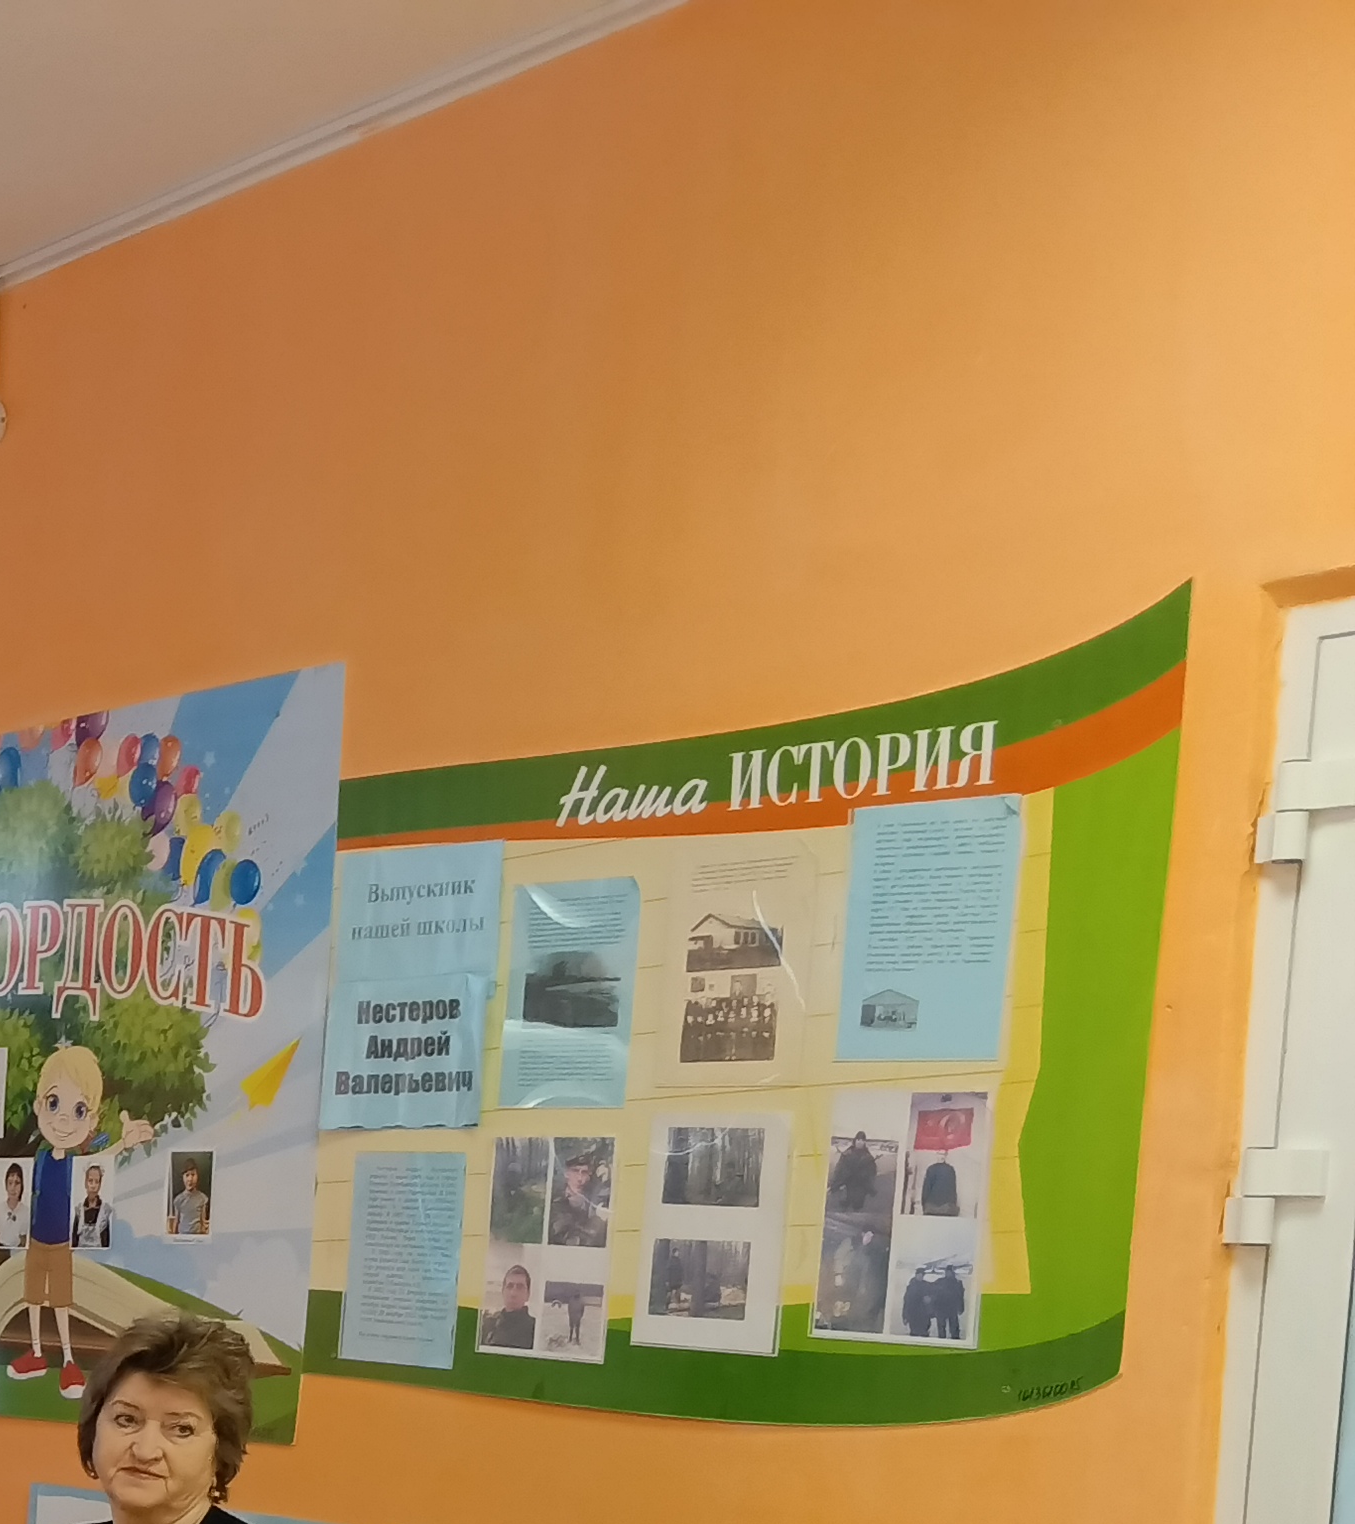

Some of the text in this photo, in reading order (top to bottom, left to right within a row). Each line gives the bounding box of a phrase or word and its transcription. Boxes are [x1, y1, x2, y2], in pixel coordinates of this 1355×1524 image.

[556, 720, 999, 828] Наша ИСТОРИЯ
[367, 879, 476, 905] Выпускник
[351, 916, 485, 940] нашей школы
[357, 998, 462, 1024] Нестеров
[365, 1029, 451, 1062] Андрей
[335, 1070, 474, 1096] Валерьевич
